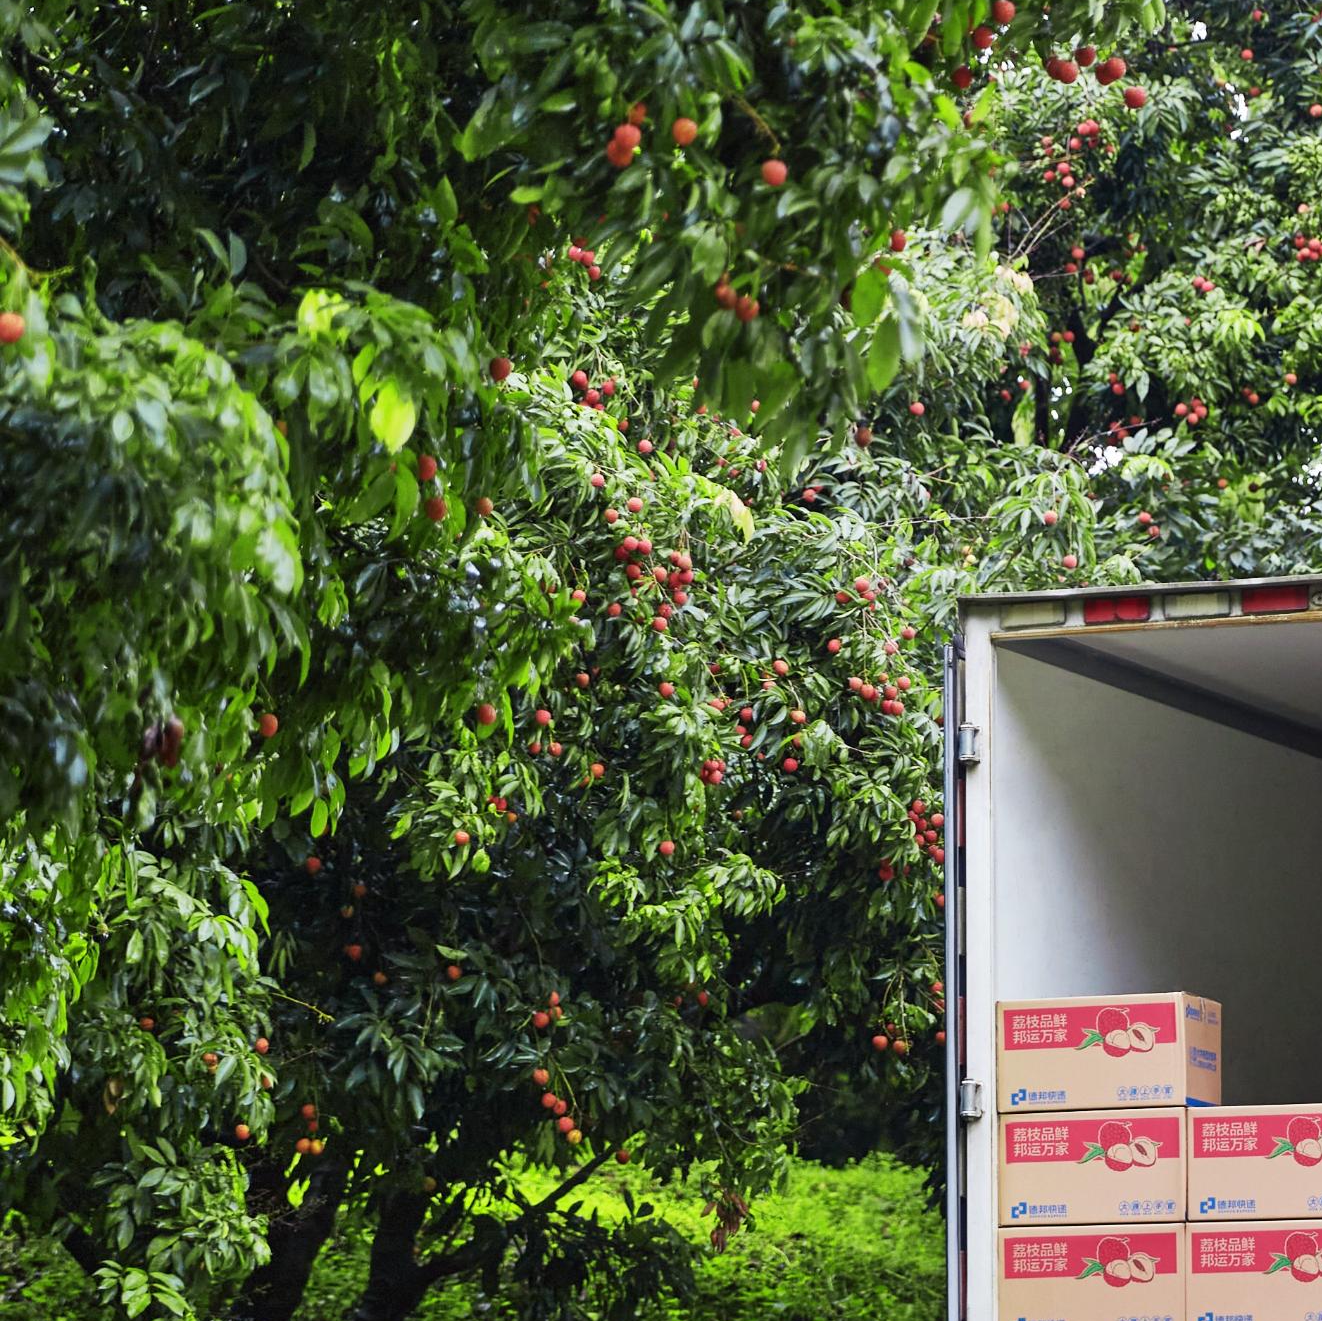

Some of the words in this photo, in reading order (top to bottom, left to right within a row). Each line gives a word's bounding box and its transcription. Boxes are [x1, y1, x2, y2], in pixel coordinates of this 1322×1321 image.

[1013, 1014, 1067, 1029] 荔枝品鲜
[1013, 1029, 1067, 1043] 邦运万家
[1014, 1127, 1068, 1142] 荔枝品鲜
[1203, 1122, 1257, 1137] 荔枝品鲜
[1014, 1142, 1068, 1156] 邦运万家
[1203, 1137, 1257, 1151] 邦运万家
[1013, 1243, 1067, 1257] 荔枝品鲜
[1201, 1237, 1255, 1252] 荔枝品鲜
[1014, 1258, 1067, 1272] 邦运万家
[1201, 1253, 1255, 1267] 邦运万家
